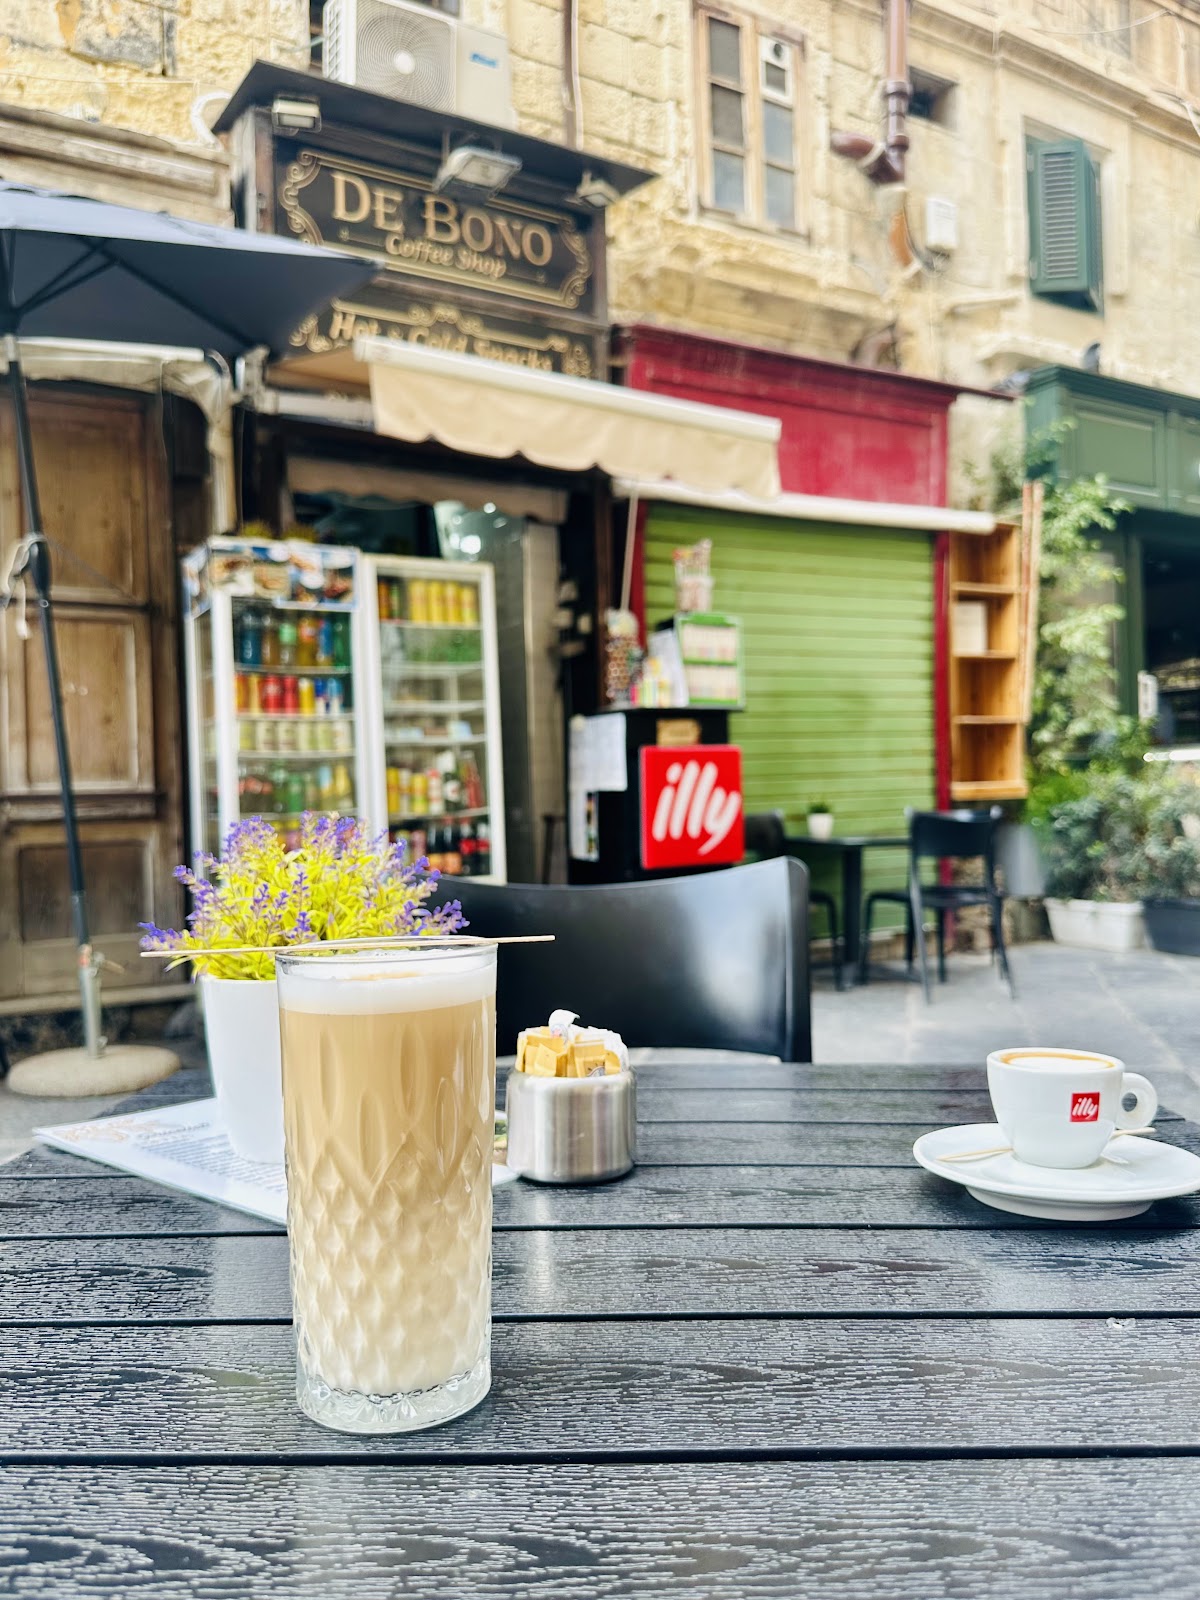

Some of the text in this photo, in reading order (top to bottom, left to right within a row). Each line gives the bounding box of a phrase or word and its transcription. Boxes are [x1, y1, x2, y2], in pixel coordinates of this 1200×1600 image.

[332, 172, 553, 266] DE BONO
[386, 234, 507, 279] Coffee Shop
[652, 760, 742, 856] illy
[1071, 1097, 1098, 1119] illy
